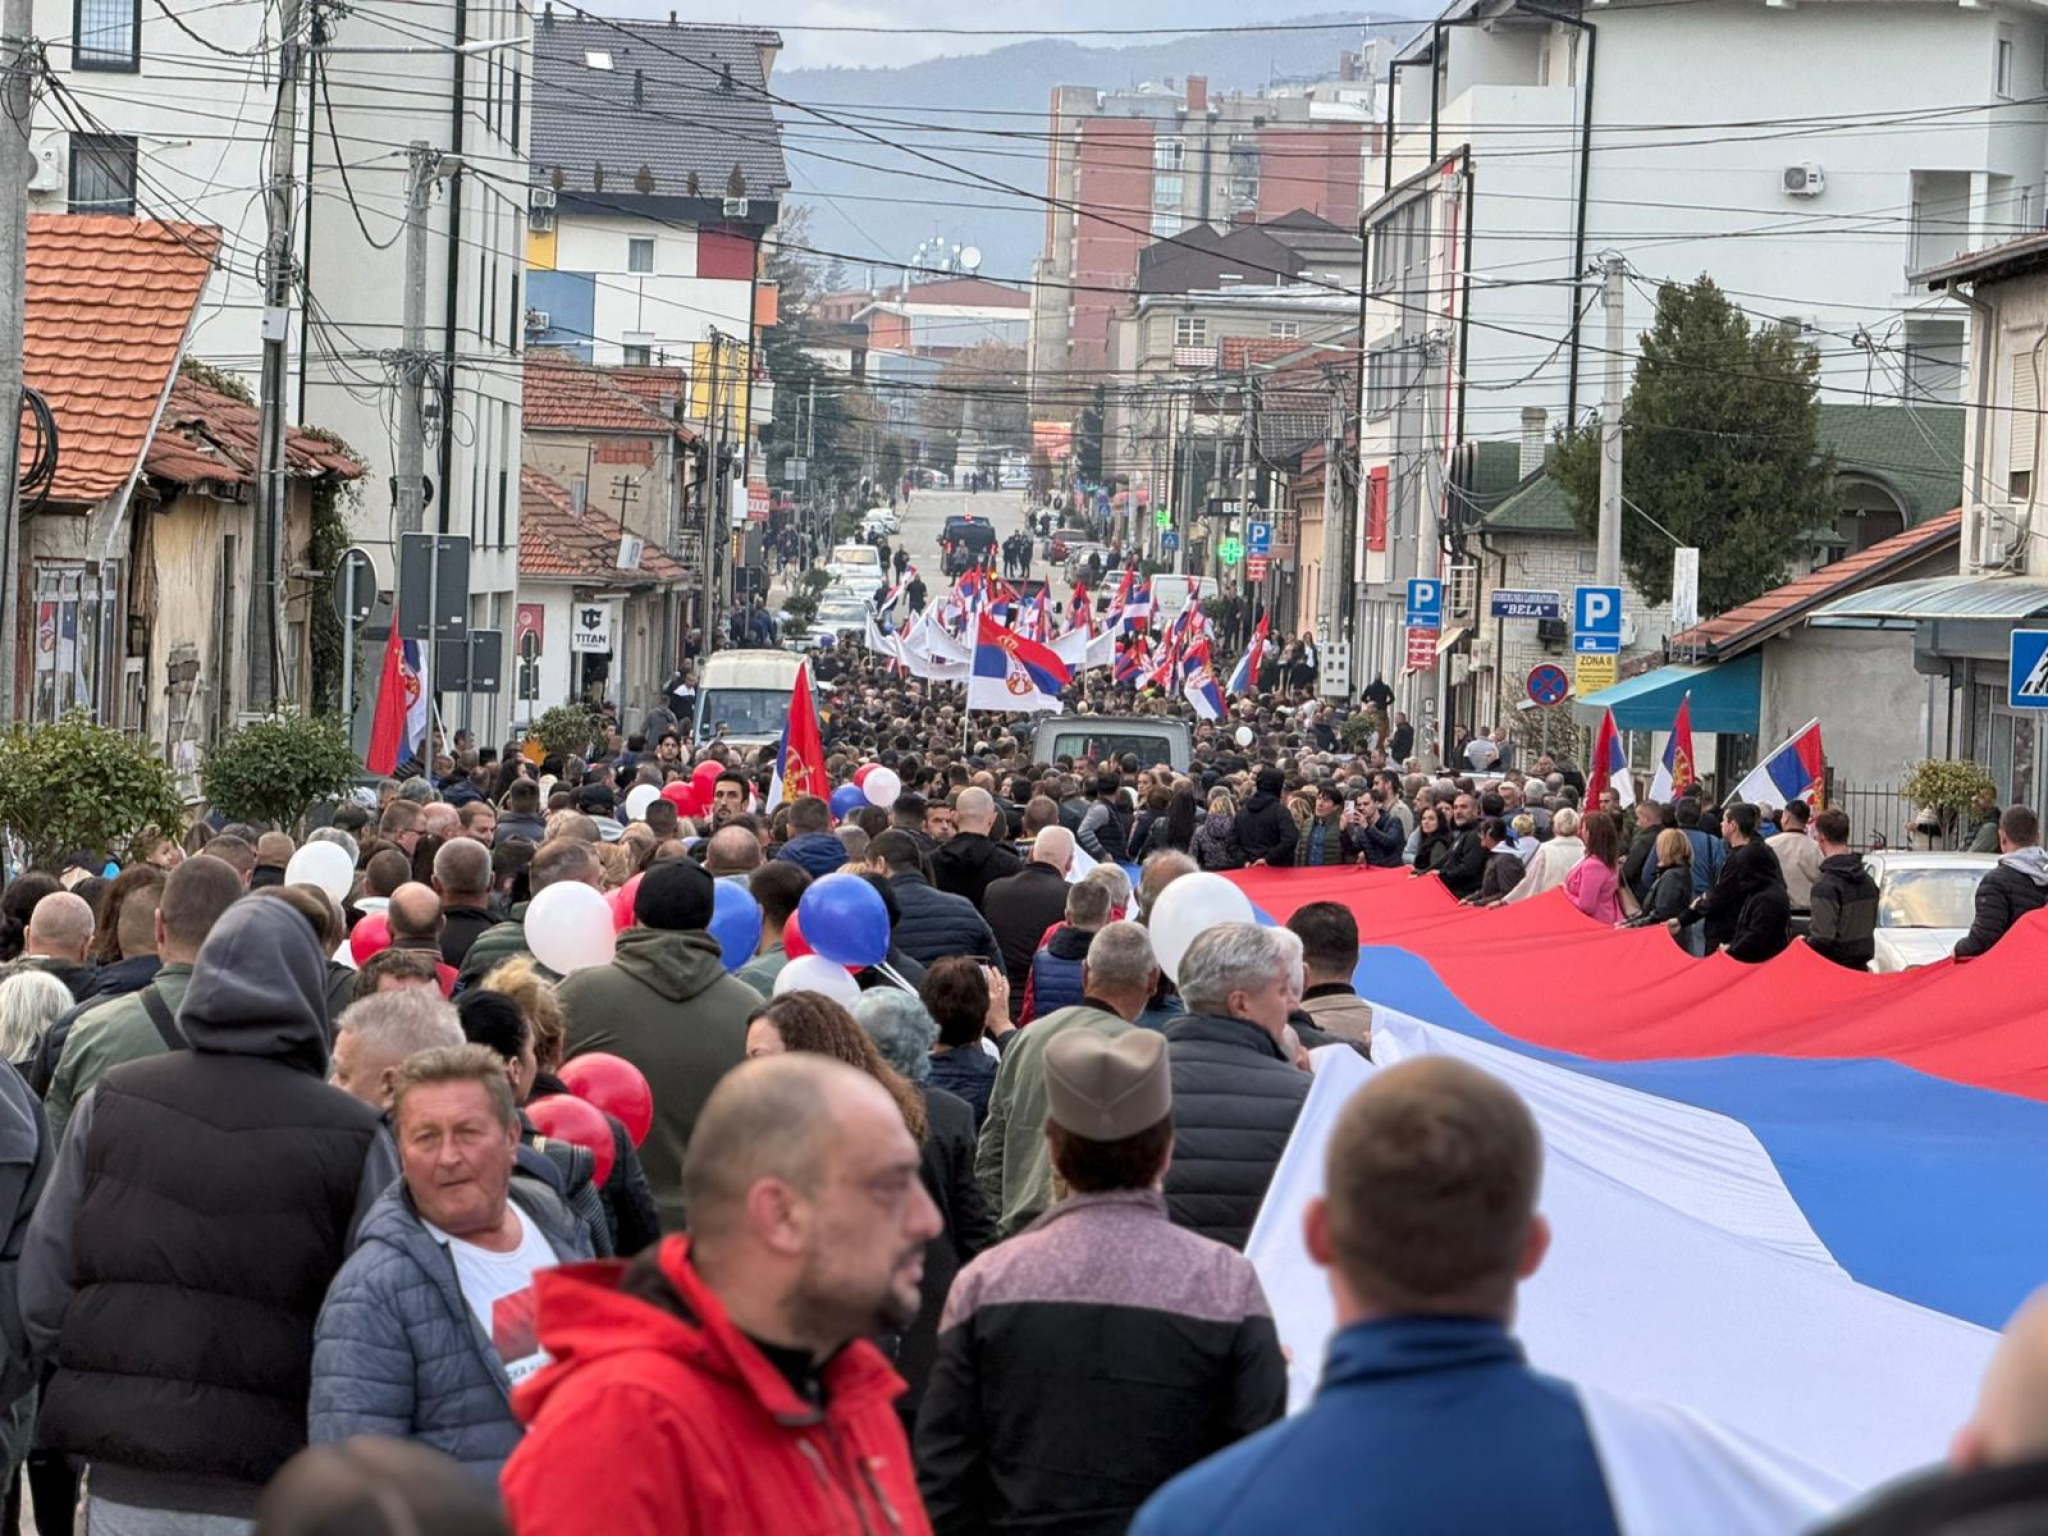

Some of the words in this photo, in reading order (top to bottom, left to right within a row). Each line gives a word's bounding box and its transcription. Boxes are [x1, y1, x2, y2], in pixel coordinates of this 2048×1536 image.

[1252, 525, 1266, 542] P
[1415, 583, 1434, 609] P
[1585, 593, 1611, 628] P
[575, 633, 606, 644] TITAN
[1580, 655, 1605, 666] ZONA
